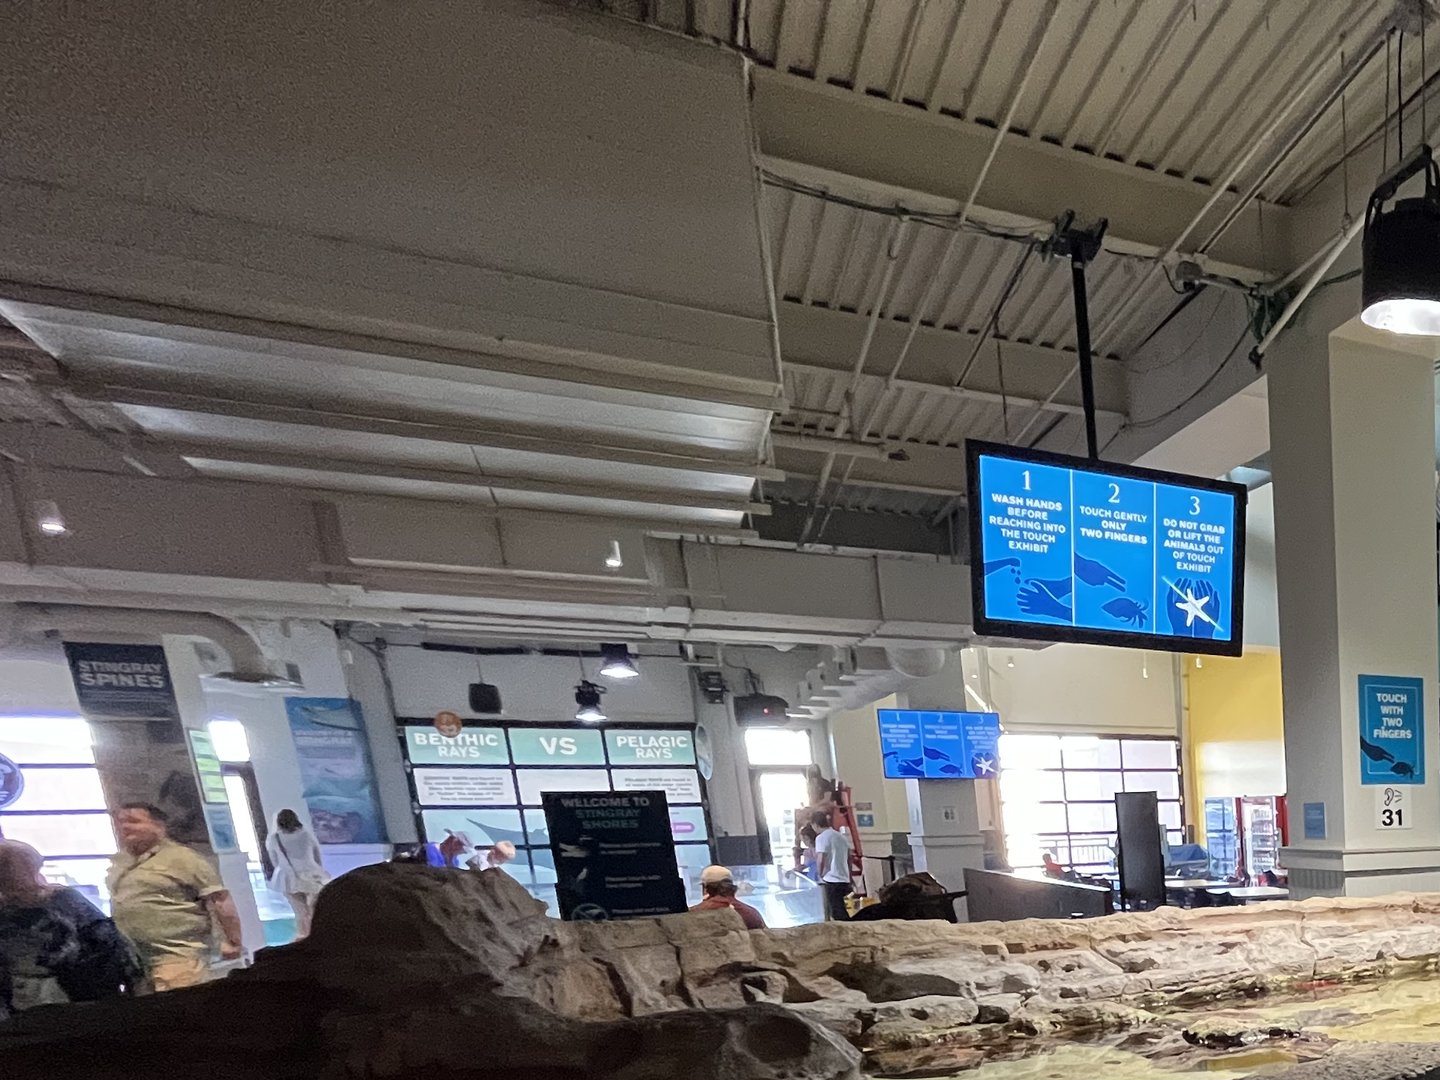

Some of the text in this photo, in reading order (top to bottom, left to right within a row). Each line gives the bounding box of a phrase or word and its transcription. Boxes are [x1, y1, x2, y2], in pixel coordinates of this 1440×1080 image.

[1022, 470, 1032, 491] 1
[1108, 483, 1120, 503] 2
[991, 493, 1063, 512] WASH HANDS
[1189, 495, 1200, 515] 3
[1007, 506, 1048, 520] BEFORE
[1079, 505, 1147, 523] TOUCH GENTLY
[989, 515, 1066, 534] REACHING INTO
[1101, 520, 1127, 531] ONLY
[1163, 518, 1226, 534] DO NOT GRAB
[1001, 528, 1056, 543] THE TOUCH
[1080, 527, 1148, 545] TWO FINGERS
[1168, 529, 1221, 544] OR LIFT THE
[1008, 540, 1049, 554] EXHIBIT
[1163, 539, 1224, 555] ANIMALS OUT
[1172, 550, 1216, 564] OF TOUCH
[1176, 561, 1212, 574] EXHIBIT
[79, 660, 162, 674] STINGRAY
[80, 673, 164, 689] SPINES
[1375, 692, 1408, 704] TOUCH
[1380, 704, 1404, 716] WITH
[1381, 716, 1403, 728] TWO
[414, 733, 498, 746] BENTHIC
[1372, 728, 1413, 739] FINGERS
[539, 736, 578, 755] VS
[616, 736, 688, 748] PELAGIC
[438, 746, 480, 758] RAYS
[636, 748, 673, 759] RAYS
[561, 797, 650, 808] WELCOME TO
[575, 808, 641, 819] STINGRAY
[1381, 808, 1403, 826] 31
[582, 819, 640, 830] SHORES
